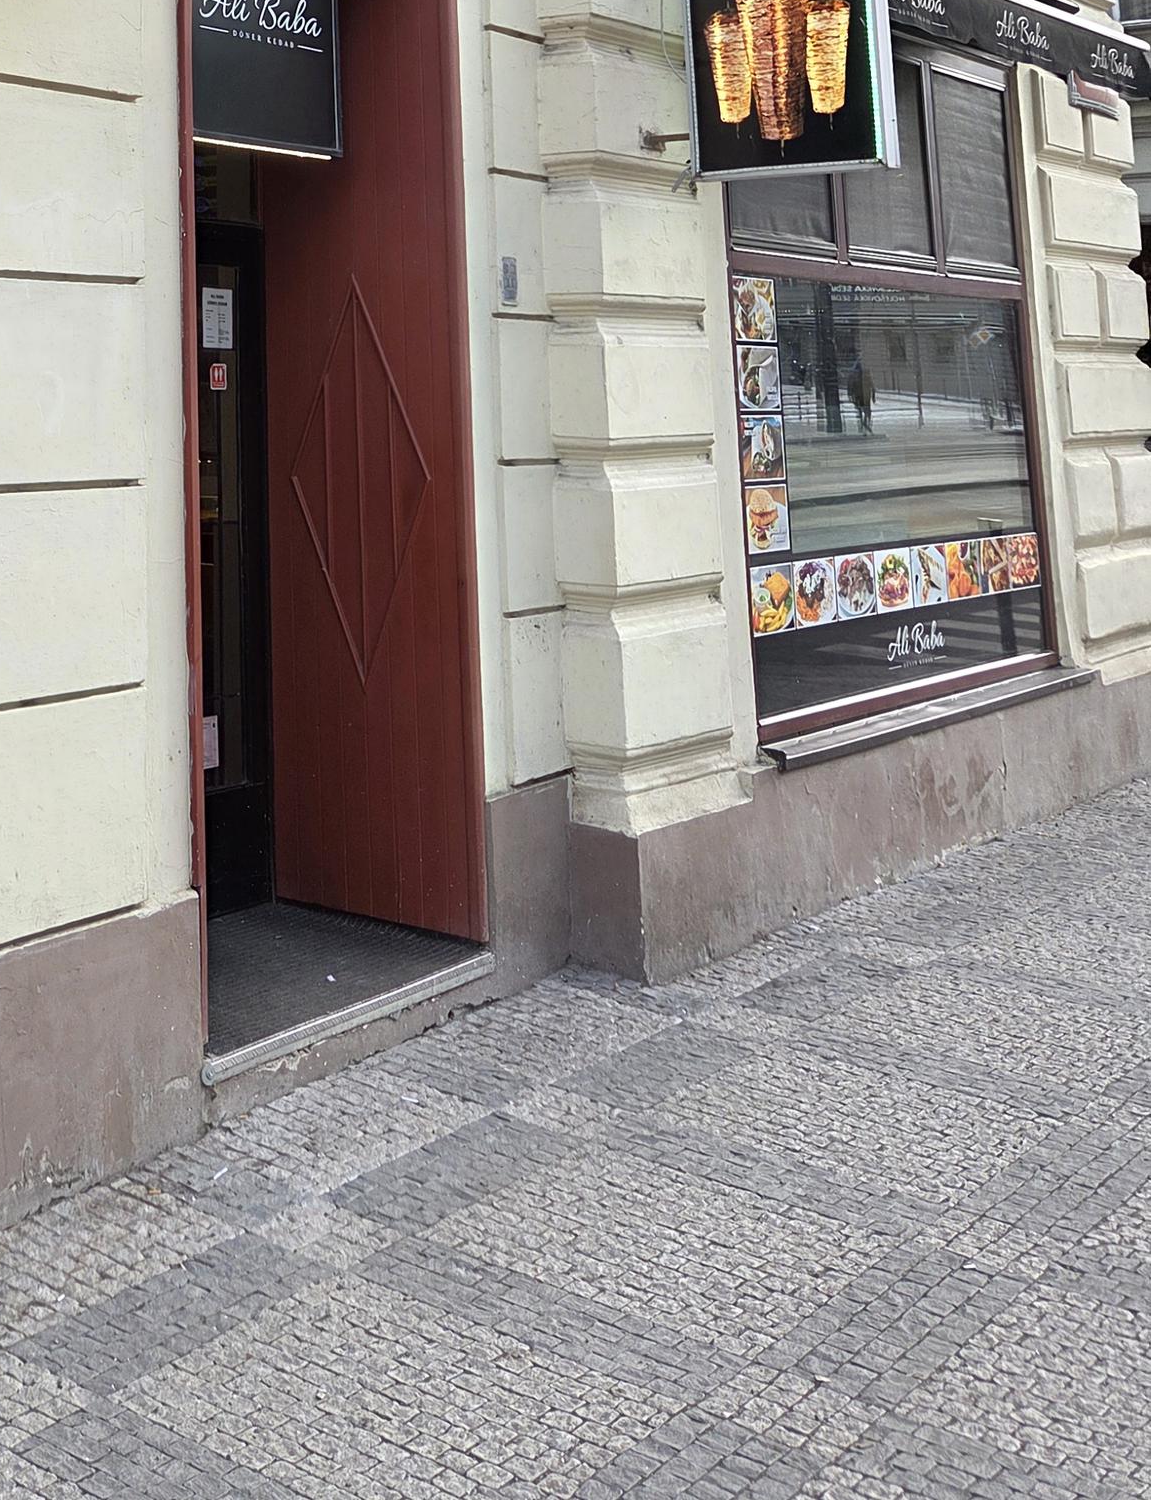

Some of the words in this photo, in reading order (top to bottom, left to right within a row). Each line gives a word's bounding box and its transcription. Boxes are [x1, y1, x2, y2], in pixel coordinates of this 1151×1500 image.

[995, 10, 1017, 39] Ali
[1016, 16, 1050, 50] Baba
[1090, 43, 1109, 70] Ali
[1108, 48, 1135, 79] Baba
[887, 625, 911, 662] Ali
[911, 620, 946, 654] Baba
